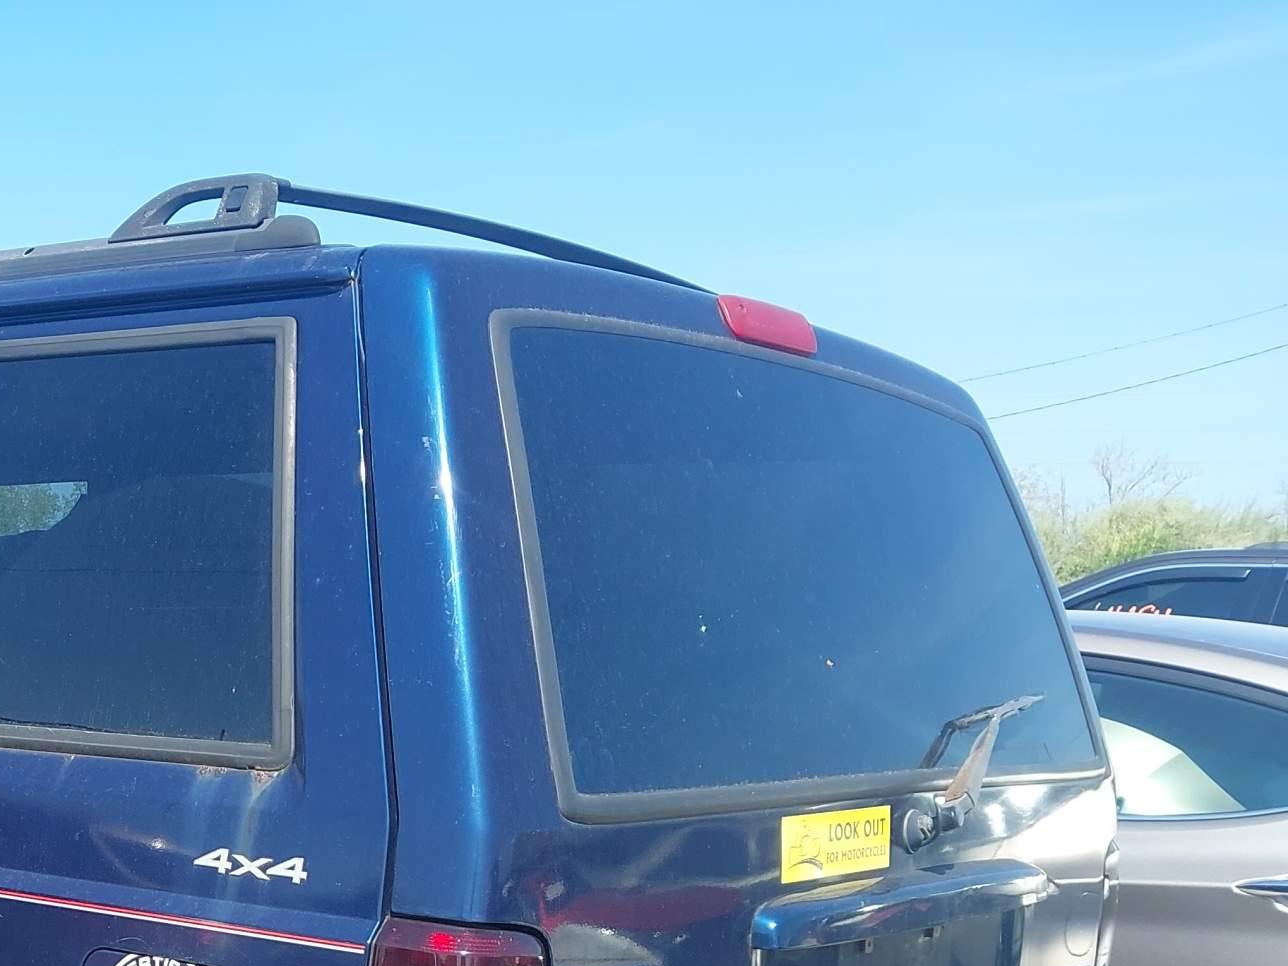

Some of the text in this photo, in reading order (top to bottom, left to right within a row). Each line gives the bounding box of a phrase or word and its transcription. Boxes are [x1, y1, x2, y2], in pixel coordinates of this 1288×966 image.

[828, 818, 886, 842] LOOK OUT
[826, 851, 840, 864] FOR
